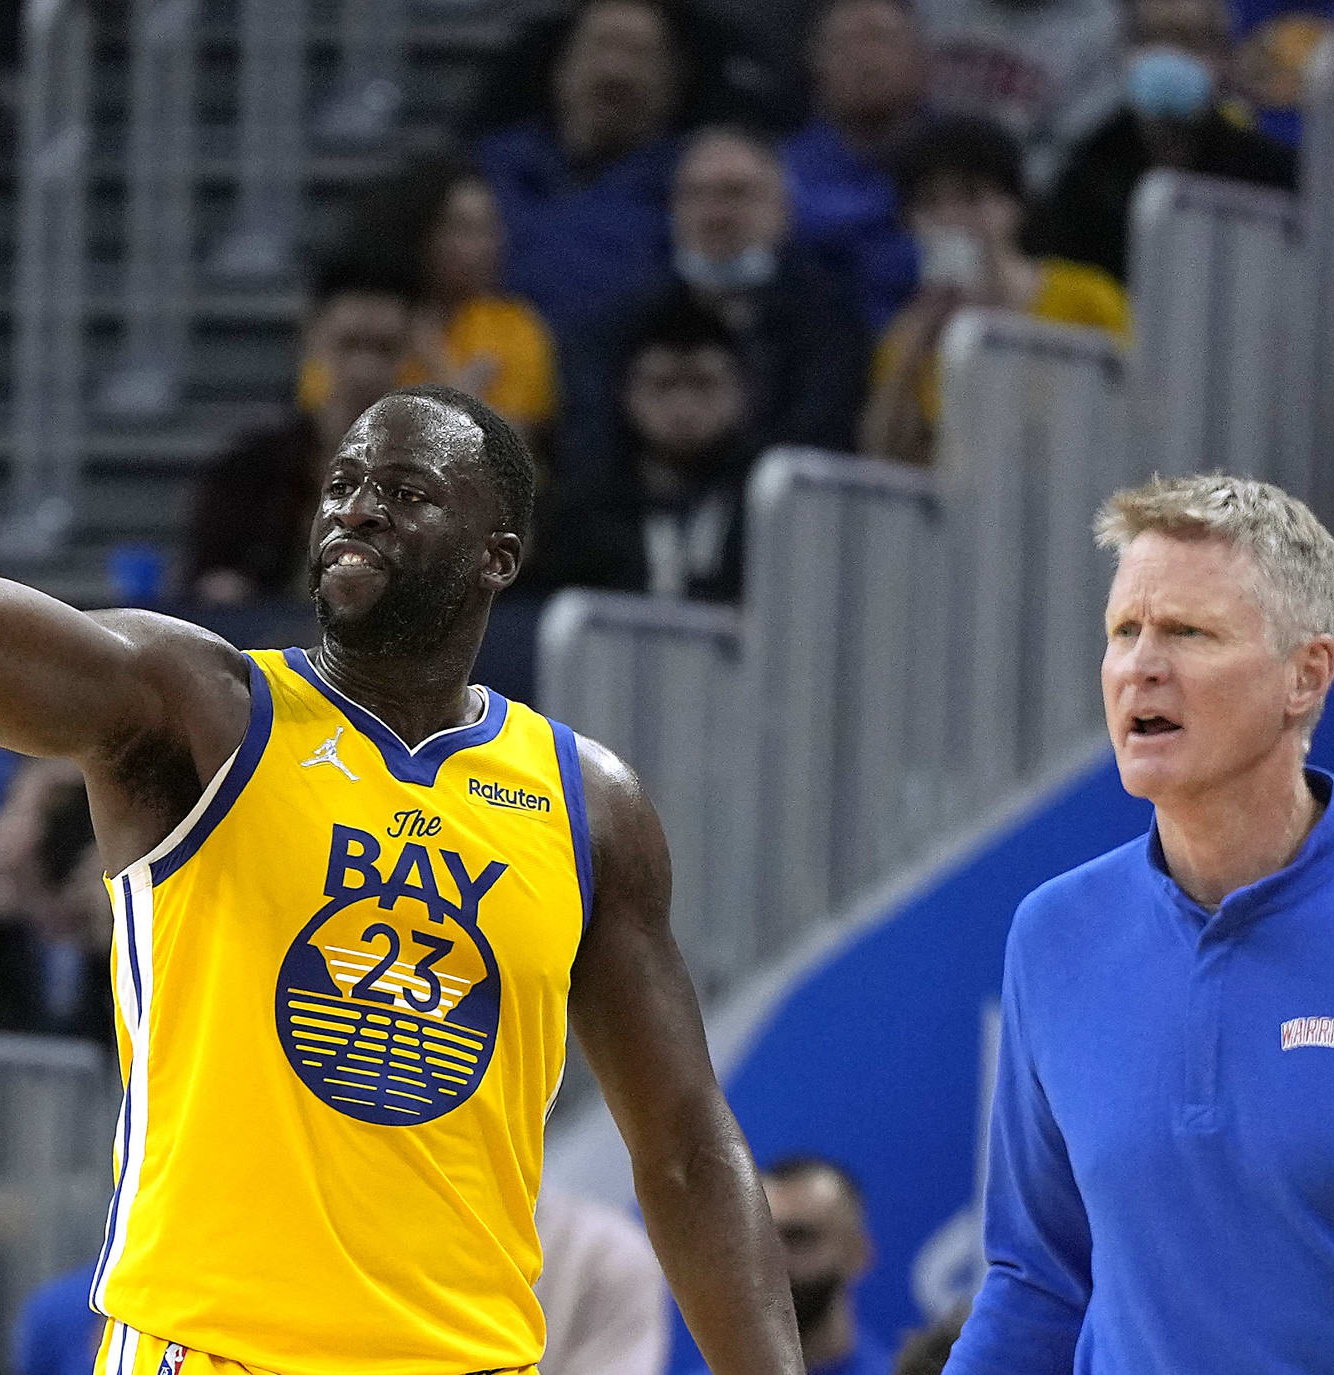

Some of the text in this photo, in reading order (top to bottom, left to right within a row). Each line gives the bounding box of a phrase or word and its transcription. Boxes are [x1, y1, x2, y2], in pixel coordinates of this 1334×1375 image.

[387, 809, 441, 838] The
[468, 778, 550, 813] Rakuten
[323, 823, 509, 926] BAY
[352, 923, 455, 1012] 23
